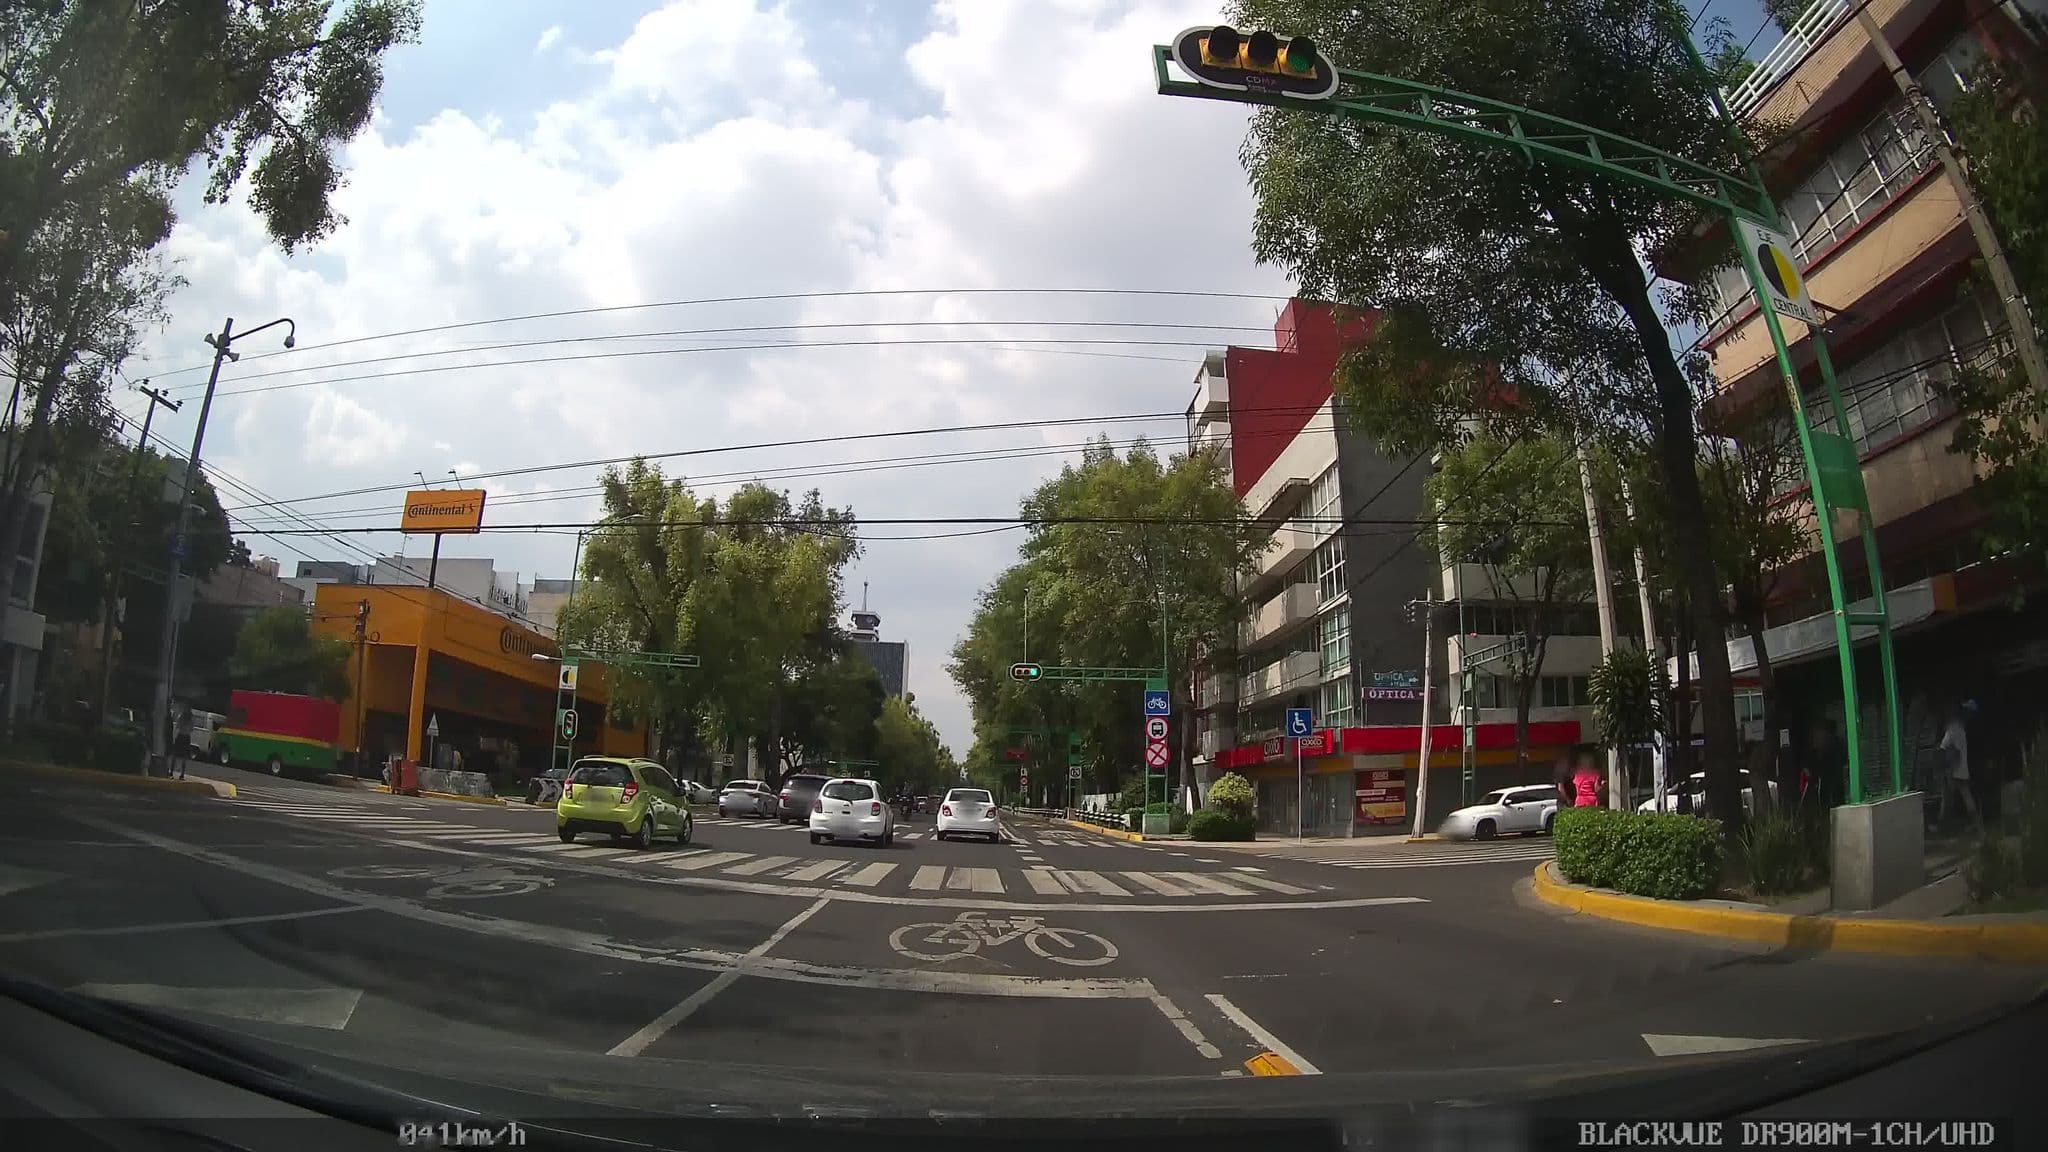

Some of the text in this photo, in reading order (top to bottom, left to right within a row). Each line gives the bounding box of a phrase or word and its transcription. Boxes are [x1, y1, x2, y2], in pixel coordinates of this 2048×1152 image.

[1756, 229, 1774, 244] EJE
[1774, 298, 1813, 320] CENTRAL
[408, 504, 465, 518] Continental
[1301, 738, 1322, 747] OXXO
